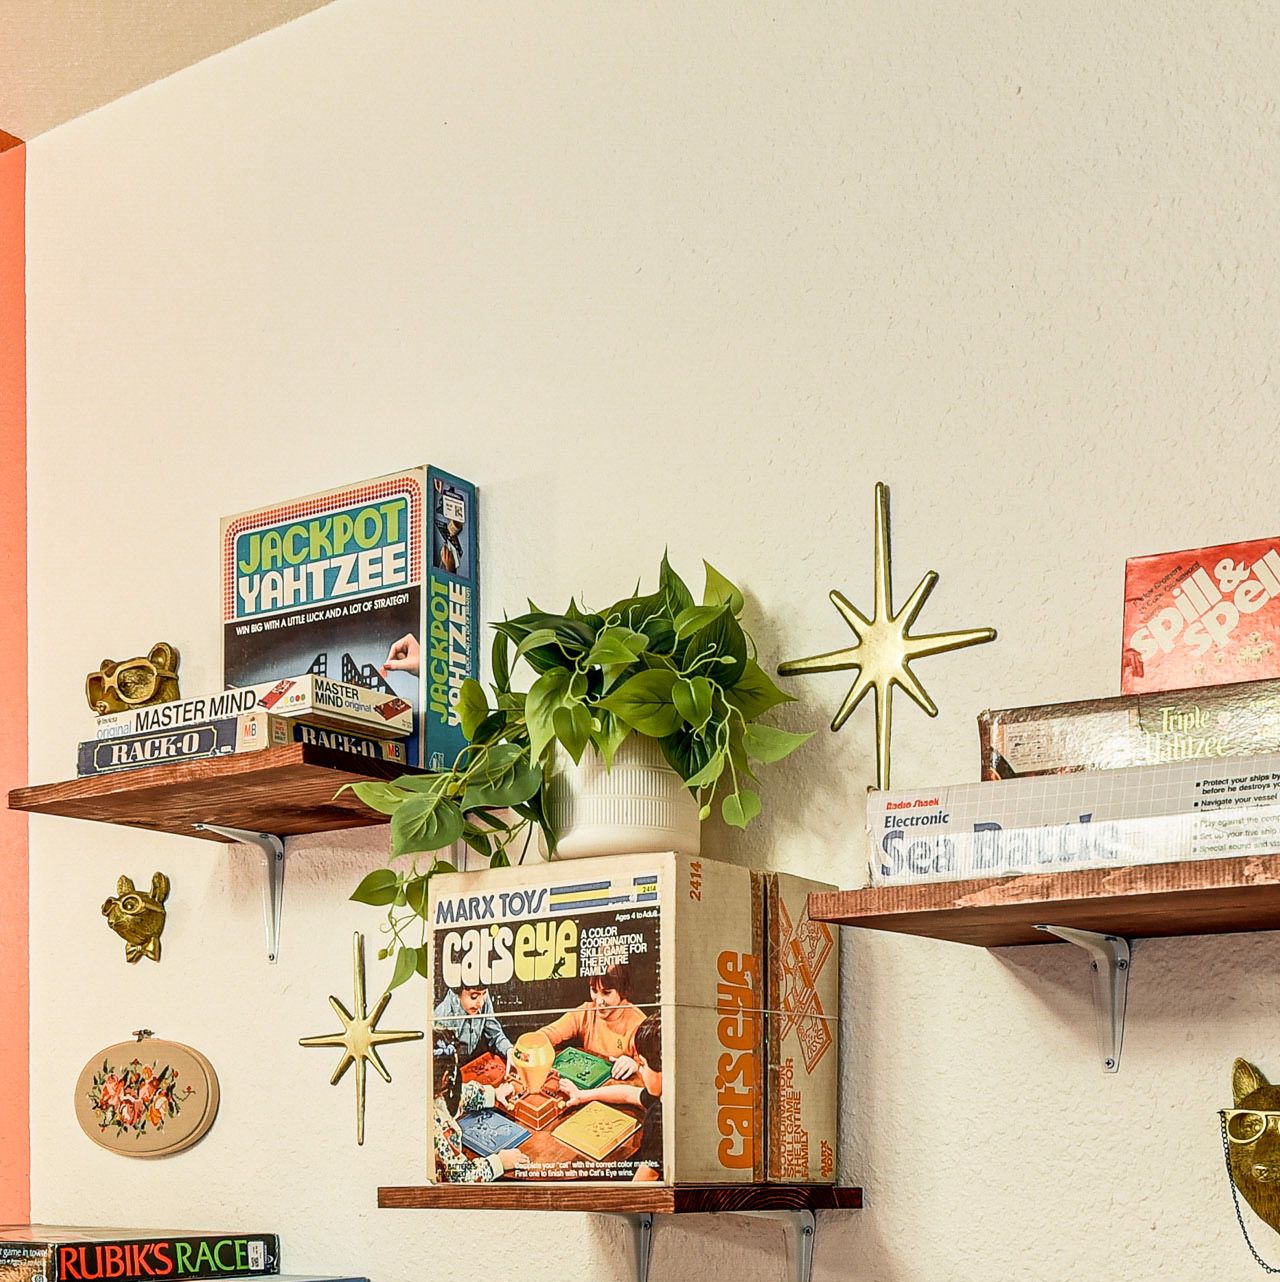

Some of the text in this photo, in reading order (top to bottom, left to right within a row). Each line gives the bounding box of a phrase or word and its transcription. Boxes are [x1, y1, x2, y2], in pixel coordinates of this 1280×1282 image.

[239, 500, 405, 574] JACKPOT
[239, 542, 405, 614] YAHTZEE
[236, 594, 409, 635] WIN BIG WITH A LITTLE LUCK AND A LOT OF STRATEGY!
[1130, 558, 1251, 661] spill &
[430, 576, 450, 724] JACKPOT
[315, 679, 359, 700] MASTER
[315, 693, 372, 713] MIND original
[97, 689, 256, 738] original MASTER MIND
[1158, 705, 1210, 733] Triple
[244, 723, 256, 737] MB
[387, 743, 400, 756] MB
[1202, 786, 1226, 795] before
[1239, 782, 1270, 792] destroys
[1203, 779, 1229, 788] Protect
[1231, 776, 1247, 787] your
[1250, 774, 1269, 786] ships
[1272, 772, 1280, 782] by
[886, 800, 911, 810] Radio
[1201, 797, 1232, 808] Navigate
[1234, 796, 1251, 806] your
[1254, 793, 1277, 802] vessel
[884, 811, 950, 828] Electronic
[881, 830, 955, 876] Sea
[642, 885, 657, 893] 2414
[689, 861, 702, 902] 2414
[436, 888, 547, 924] MARX TOYS
[615, 913, 630, 922] Ages
[580, 934, 643, 948] COORDINATION
[581, 927, 617, 939] A COLOR
[443, 919, 578, 987] cat's eye
[580, 943, 647, 957] SKILL GAME FOR
[580, 955, 629, 967] THE ENTIRE
[580, 966, 608, 977] FAMILY
[715, 950, 761, 1169] cat's eye
[786, 1058, 794, 1178] SKILL GAME FOR
[793, 1091, 802, 1178] THE ENTIRE
[801, 1129, 809, 1178] FAMILY
[605, 1170, 617, 1178] Eye
[3, 1248, 22, 1258] game
[22, 1248, 29, 1257] in
[60, 1242, 174, 1281] RUBIK'S
[175, 1239, 249, 1274] RACE
